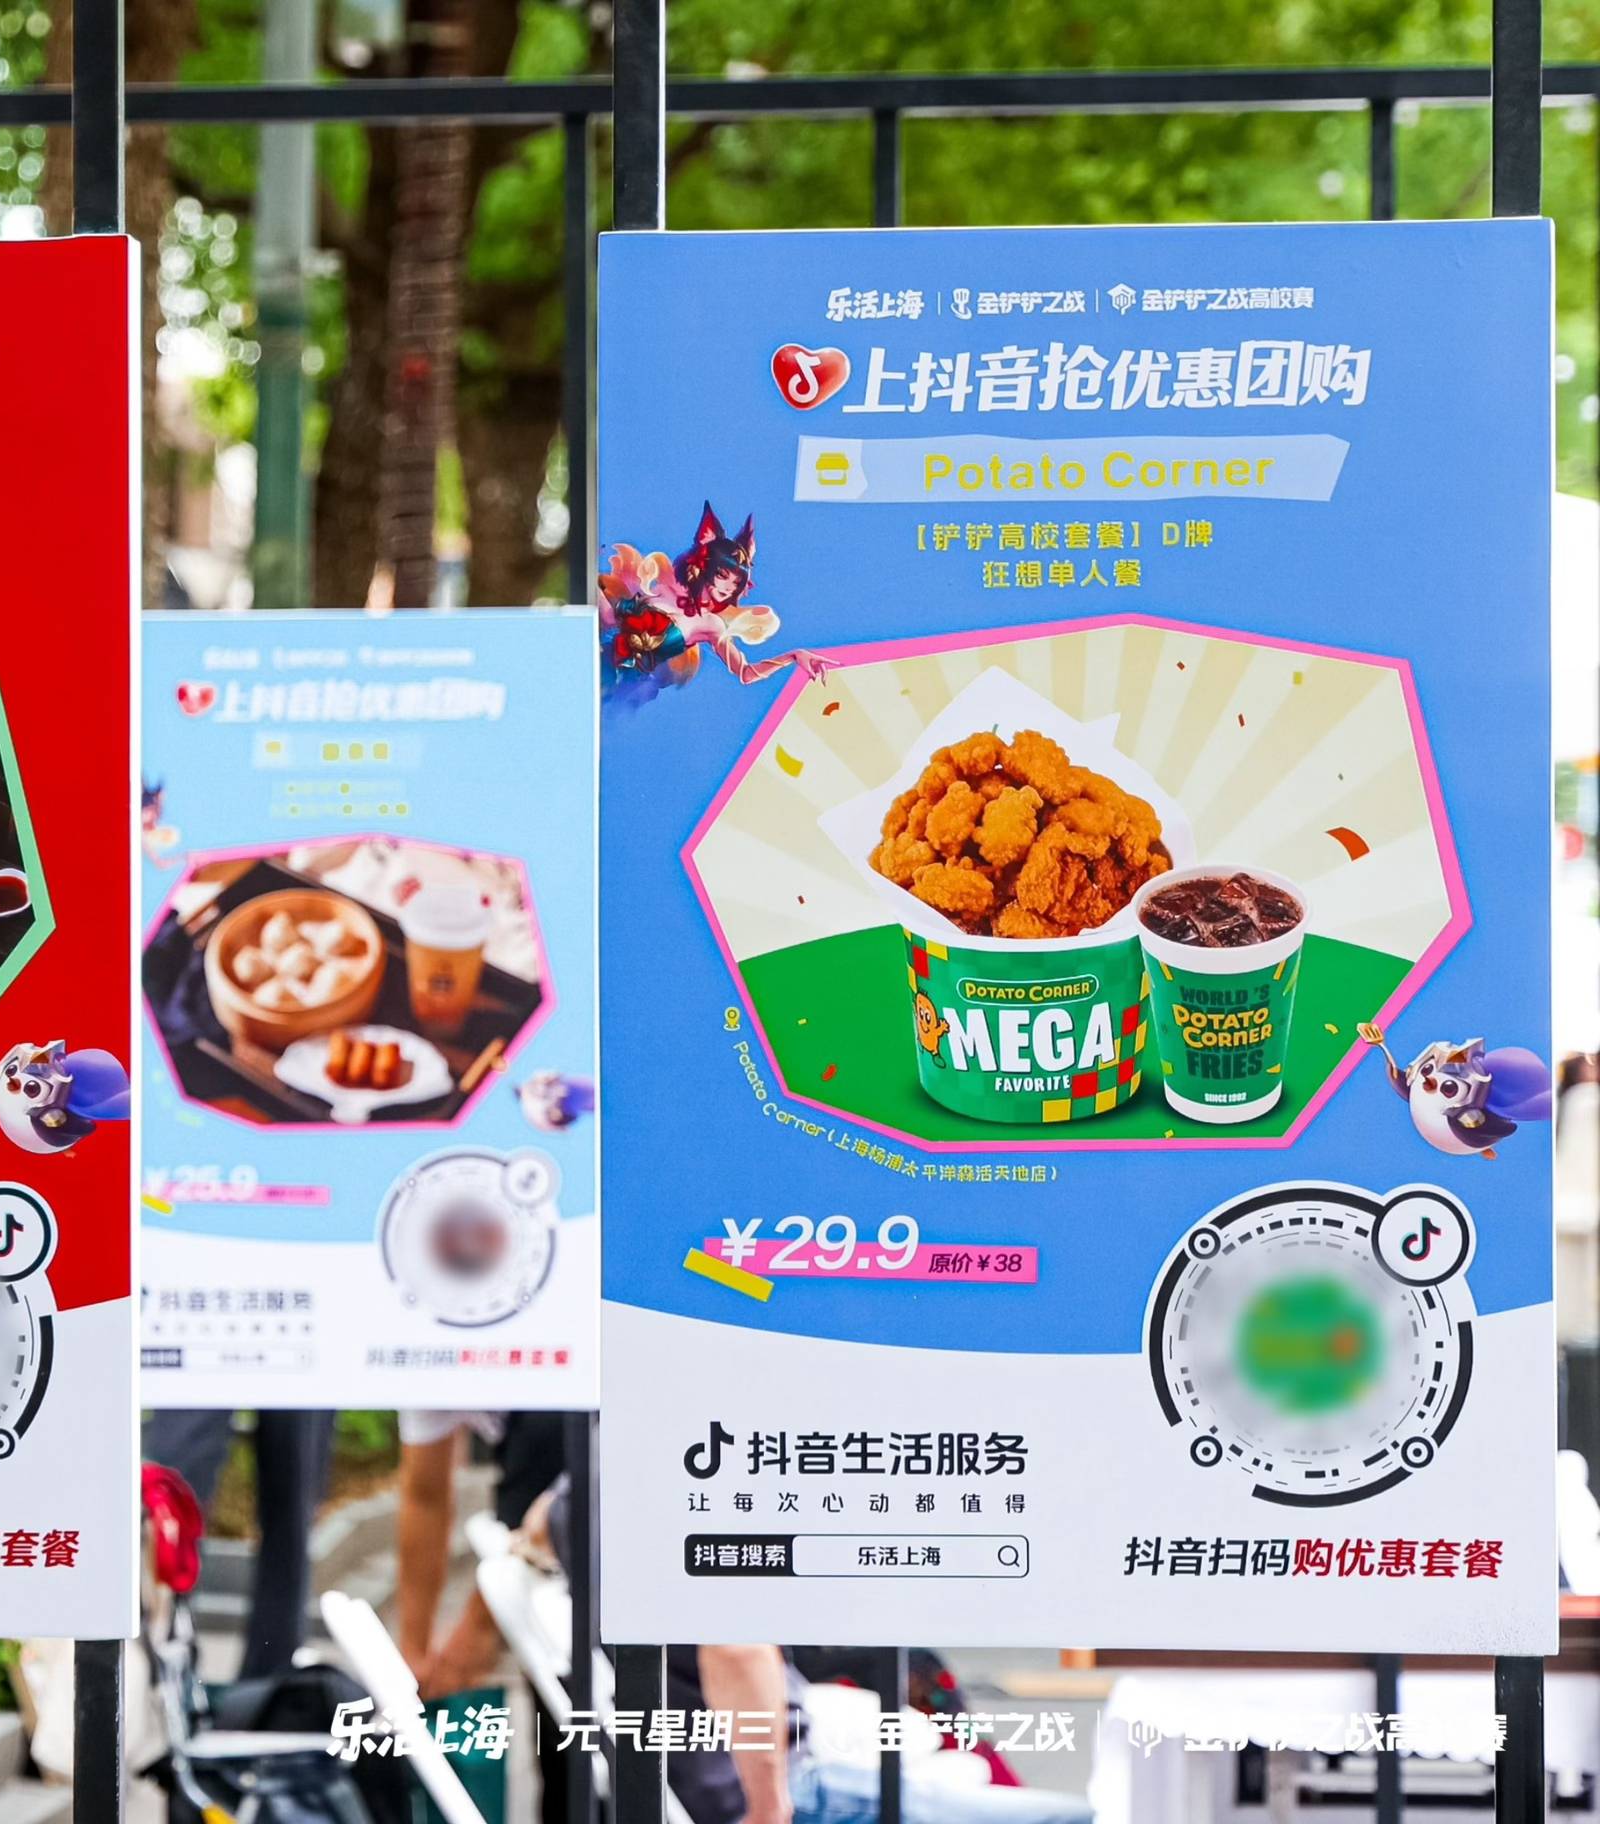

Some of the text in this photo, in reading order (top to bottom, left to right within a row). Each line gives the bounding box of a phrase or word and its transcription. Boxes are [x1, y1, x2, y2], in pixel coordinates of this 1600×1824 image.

[825, 286, 1315, 321] 乐活上海 金铲铲之战 金铲铲之战高校赛
[842, 340, 1372, 414] 上抖音抢优惠团购
[923, 450, 1277, 492] Potato Corner
[1162, 518, 1215, 549] D牌
[982, 557, 1143, 590] 狂想单人餐
[965, 981, 1091, 1001] POTATO CORNER
[1172, 1003, 1270, 1029] POTATO
[942, 1001, 1117, 1074] MEGA
[1182, 1022, 1273, 1049] CORNER
[1185, 1048, 1264, 1080] FRIES
[995, 1074, 1072, 1093] FAVORITE
[720, 1214, 920, 1271] ¥29.9
[746, 1430, 1029, 1478] 抖音生活服务
[694, 1543, 943, 1568] 抖音搜索 乐活上海
[1123, 1536, 1505, 1580] 抖音扫码购优惠套餐
